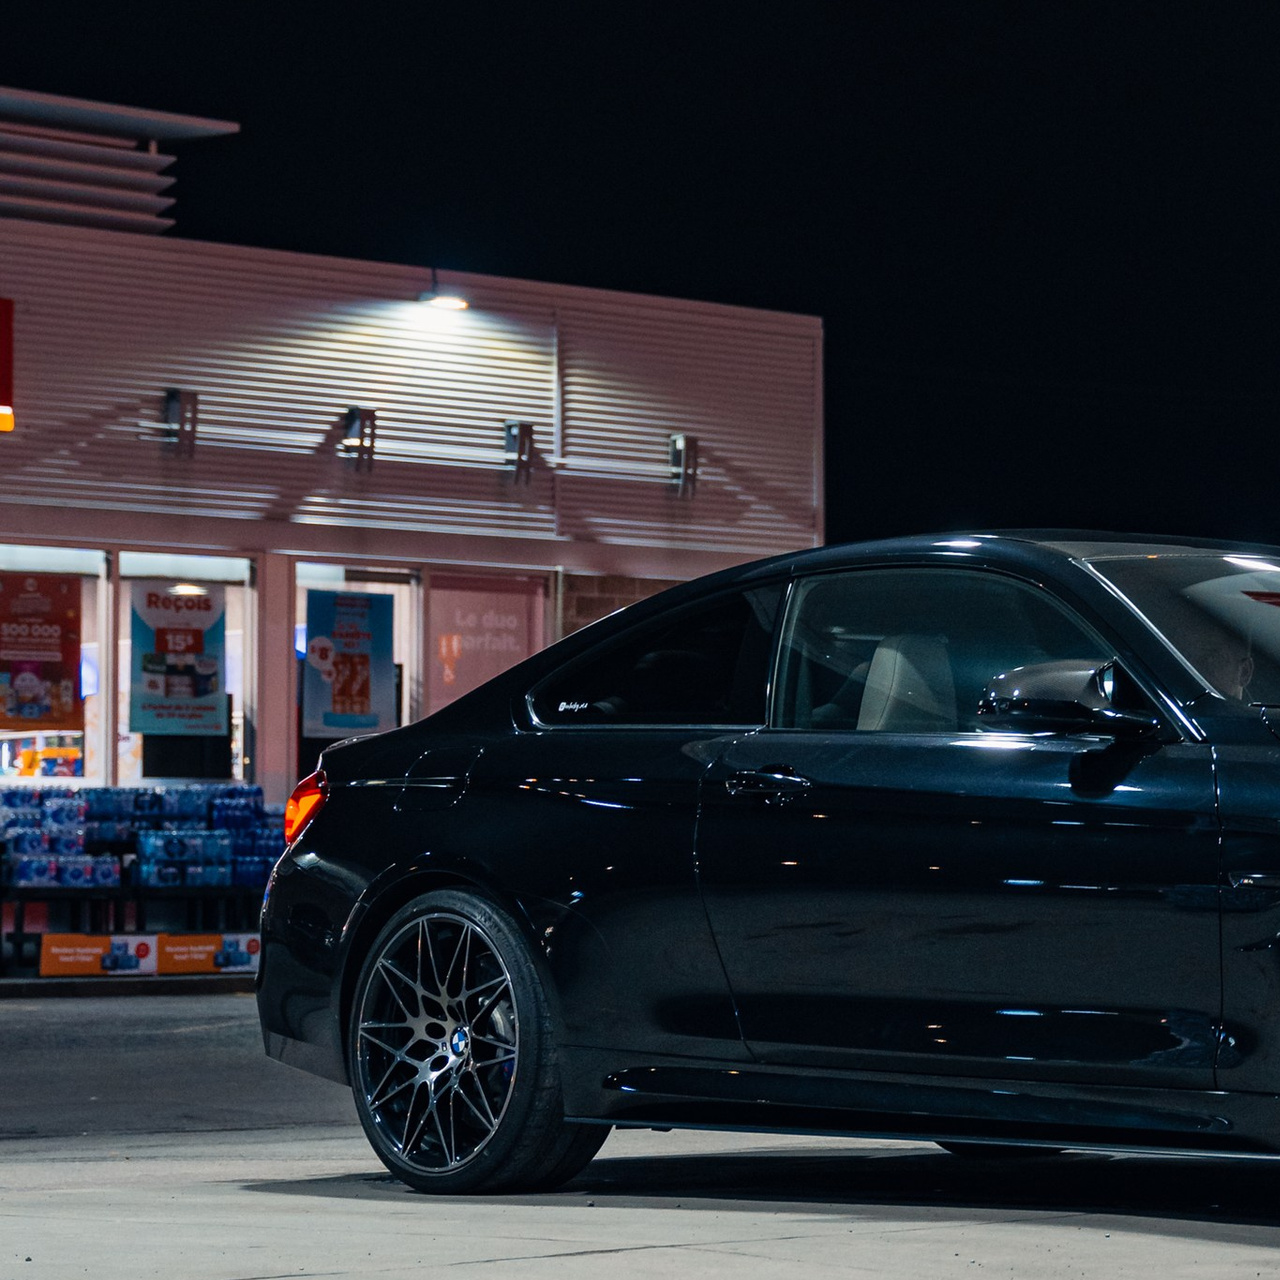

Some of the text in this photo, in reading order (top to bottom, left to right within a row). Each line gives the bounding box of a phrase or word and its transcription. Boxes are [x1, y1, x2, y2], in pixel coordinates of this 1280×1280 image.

[146, 592, 213, 613] Reçois
[455, 609, 517, 629] Le duo
